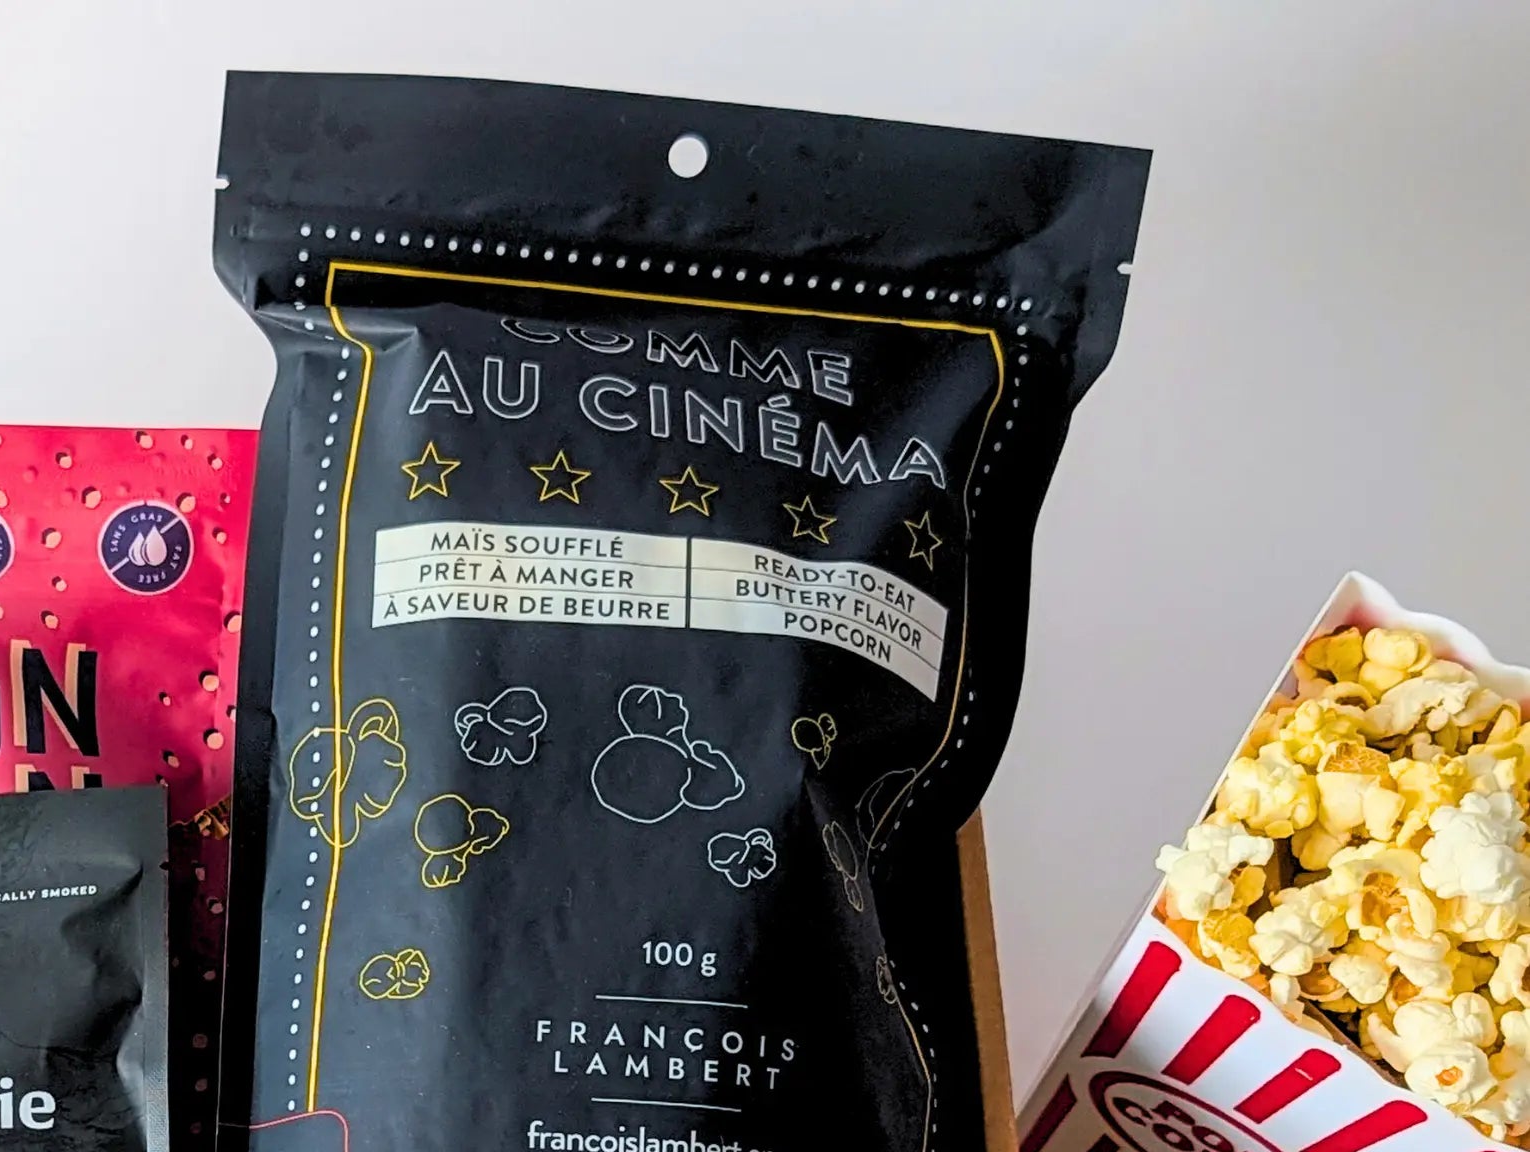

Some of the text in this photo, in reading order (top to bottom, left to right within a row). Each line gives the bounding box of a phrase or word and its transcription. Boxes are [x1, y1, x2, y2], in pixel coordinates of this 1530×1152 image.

[408, 349, 947, 491] AU CINÉMA
[110, 512, 163, 553] SANS GRAS
[430, 528, 624, 559] MAÏS SOUFFLÉ
[419, 556, 635, 589] PRÊT À MANGER
[754, 554, 916, 614] READY-TO-EAT
[383, 592, 671, 621] À SAVEUR DE BEURRE
[736, 579, 923, 649] BUTTERY FLAVOR
[784, 611, 891, 663] POPCORN
[41, 885, 98, 899] SMOKED
[642, 941, 717, 977] 100 g
[536, 1019, 796, 1062] FRANÇOIS
[554, 1051, 780, 1090] LAMBERT
